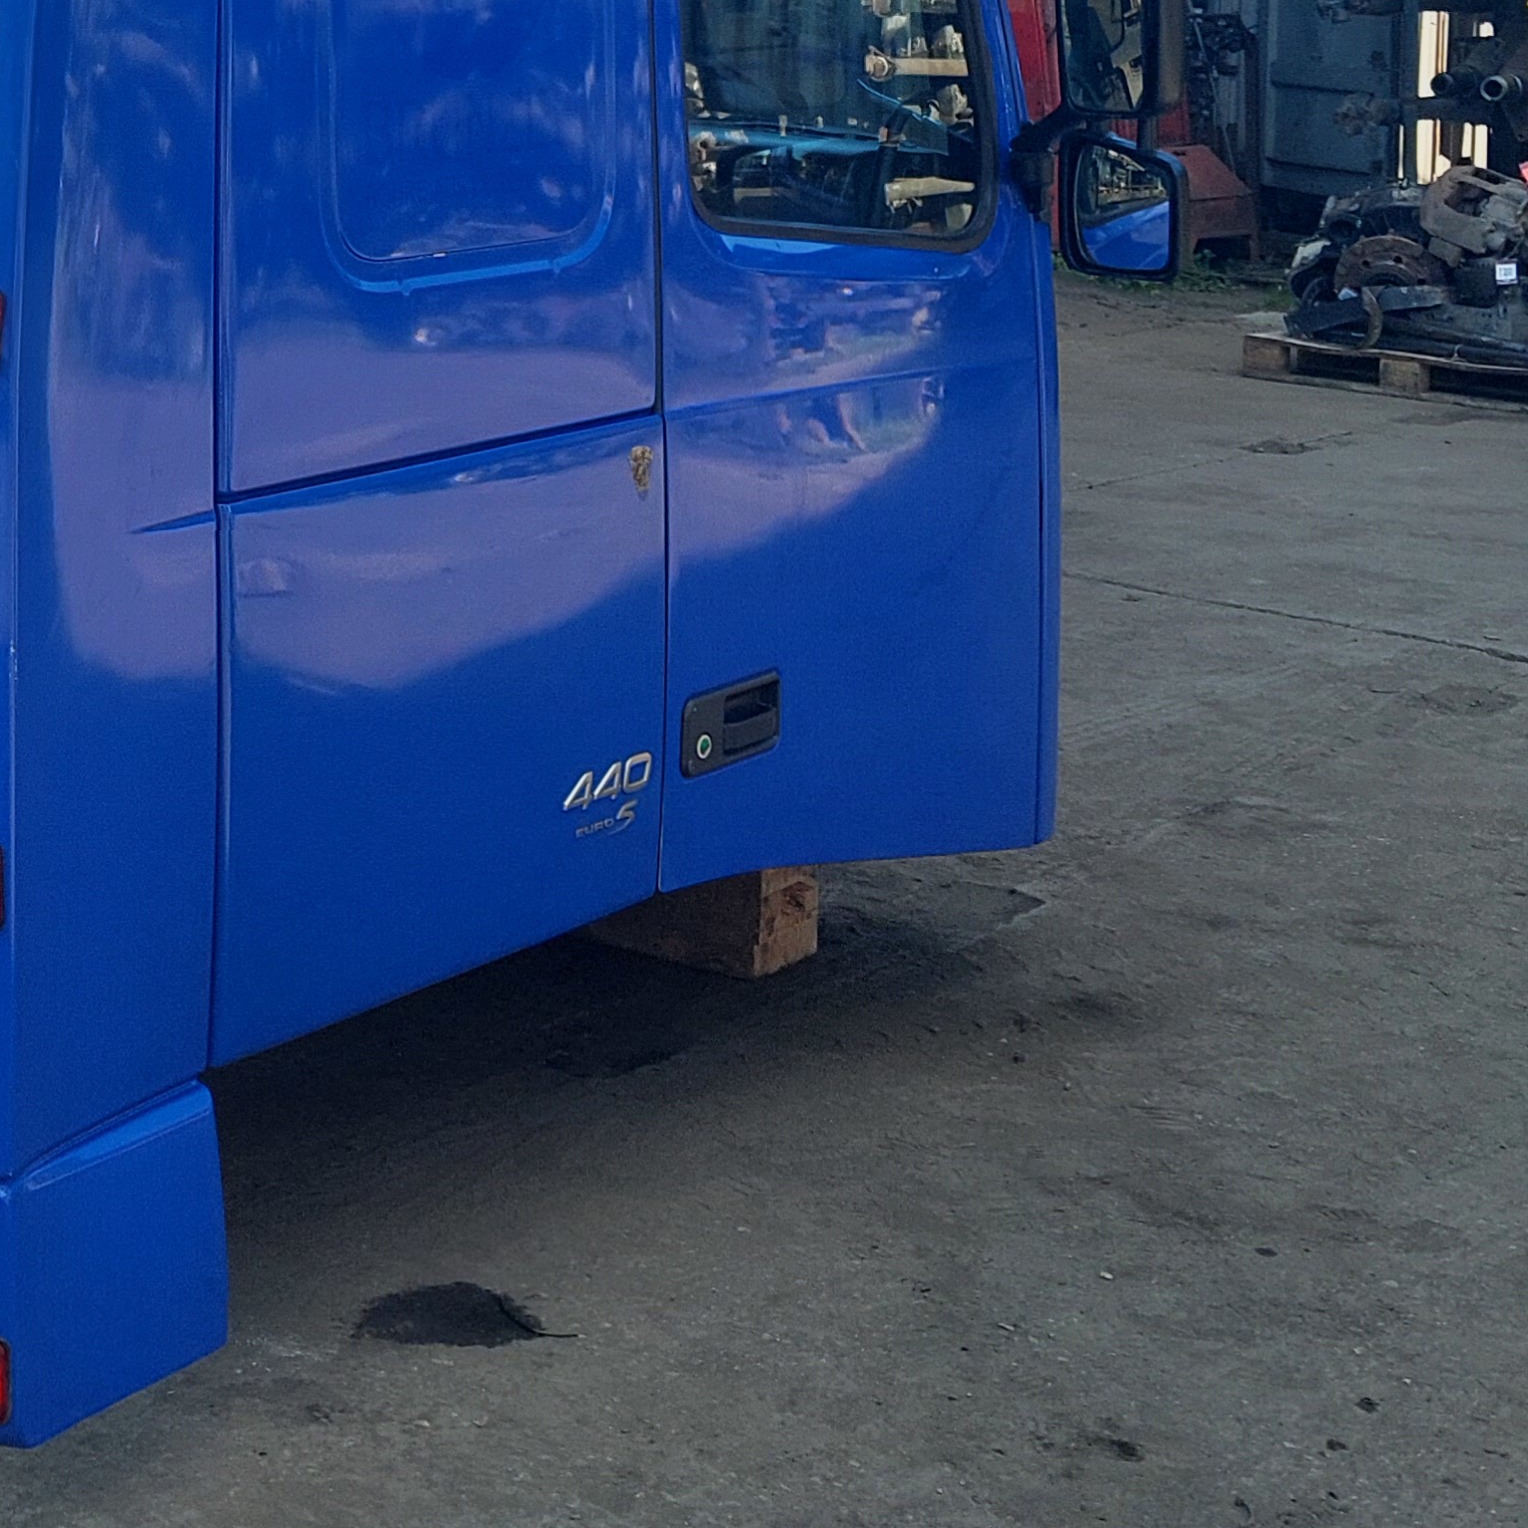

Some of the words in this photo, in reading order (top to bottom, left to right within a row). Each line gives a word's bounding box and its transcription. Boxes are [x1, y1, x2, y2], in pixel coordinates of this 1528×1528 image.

[563, 752, 652, 811] 440
[575, 817, 615, 838] EURO
[608, 799, 639, 835] 5
